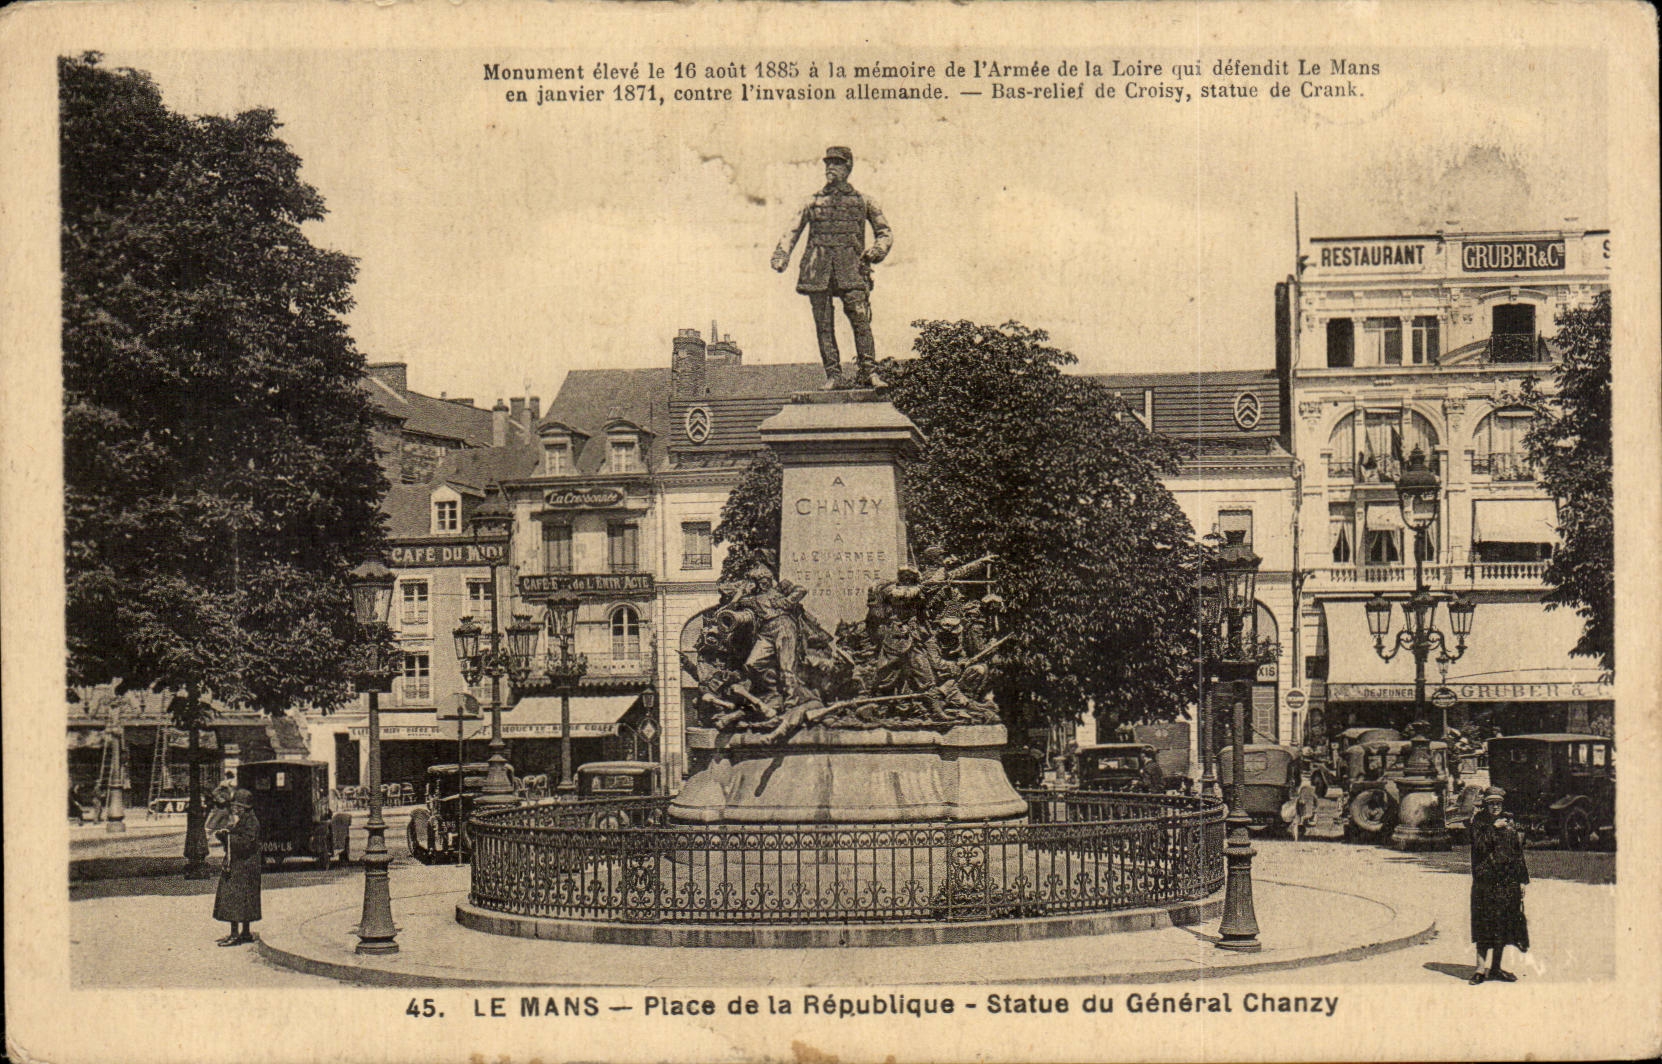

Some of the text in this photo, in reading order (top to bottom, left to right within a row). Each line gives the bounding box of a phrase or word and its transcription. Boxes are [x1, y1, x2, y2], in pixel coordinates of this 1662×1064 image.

[1321, 244, 1425, 267] RESTAURANT
[831, 476, 846, 488] A
[549, 493, 564, 504] La
[794, 497, 883, 516] CHANZY
[442, 547, 463, 561] DU
[1460, 684, 1560, 698] GRUBER
